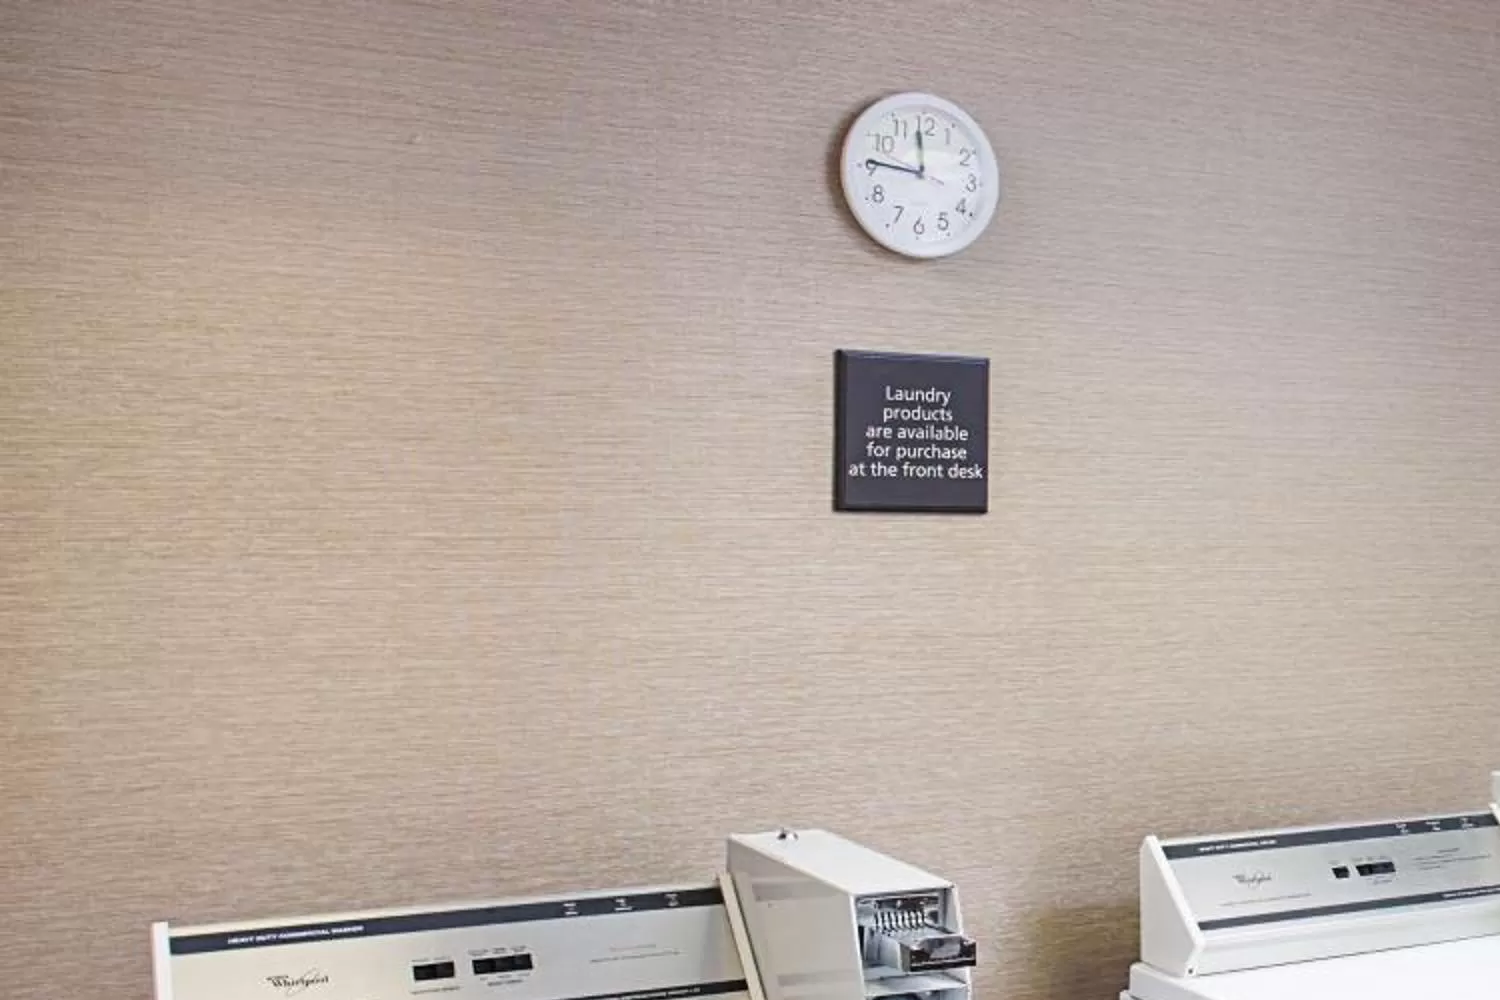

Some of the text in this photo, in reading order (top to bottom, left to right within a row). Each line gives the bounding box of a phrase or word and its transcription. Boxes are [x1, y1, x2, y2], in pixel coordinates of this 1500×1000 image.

[892, 117, 908, 139] 11
[916, 115, 936, 136] 12
[872, 133, 895, 154] 10
[944, 127, 951, 146] 1
[959, 147, 971, 167] 2
[966, 173, 977, 193] 3
[872, 184, 885, 204] 8
[893, 205, 905, 224] 7
[955, 197, 967, 215] 4
[913, 216, 925, 235] 6
[937, 211, 949, 231] 5
[885, 385, 951, 407] Laundry
[883, 406, 953, 422] products
[865, 425, 969, 441] are available
[866, 441, 967, 461] for purchase
[848, 461, 983, 479] at the front desk
[270, 972, 329, 991] Whirlpool
